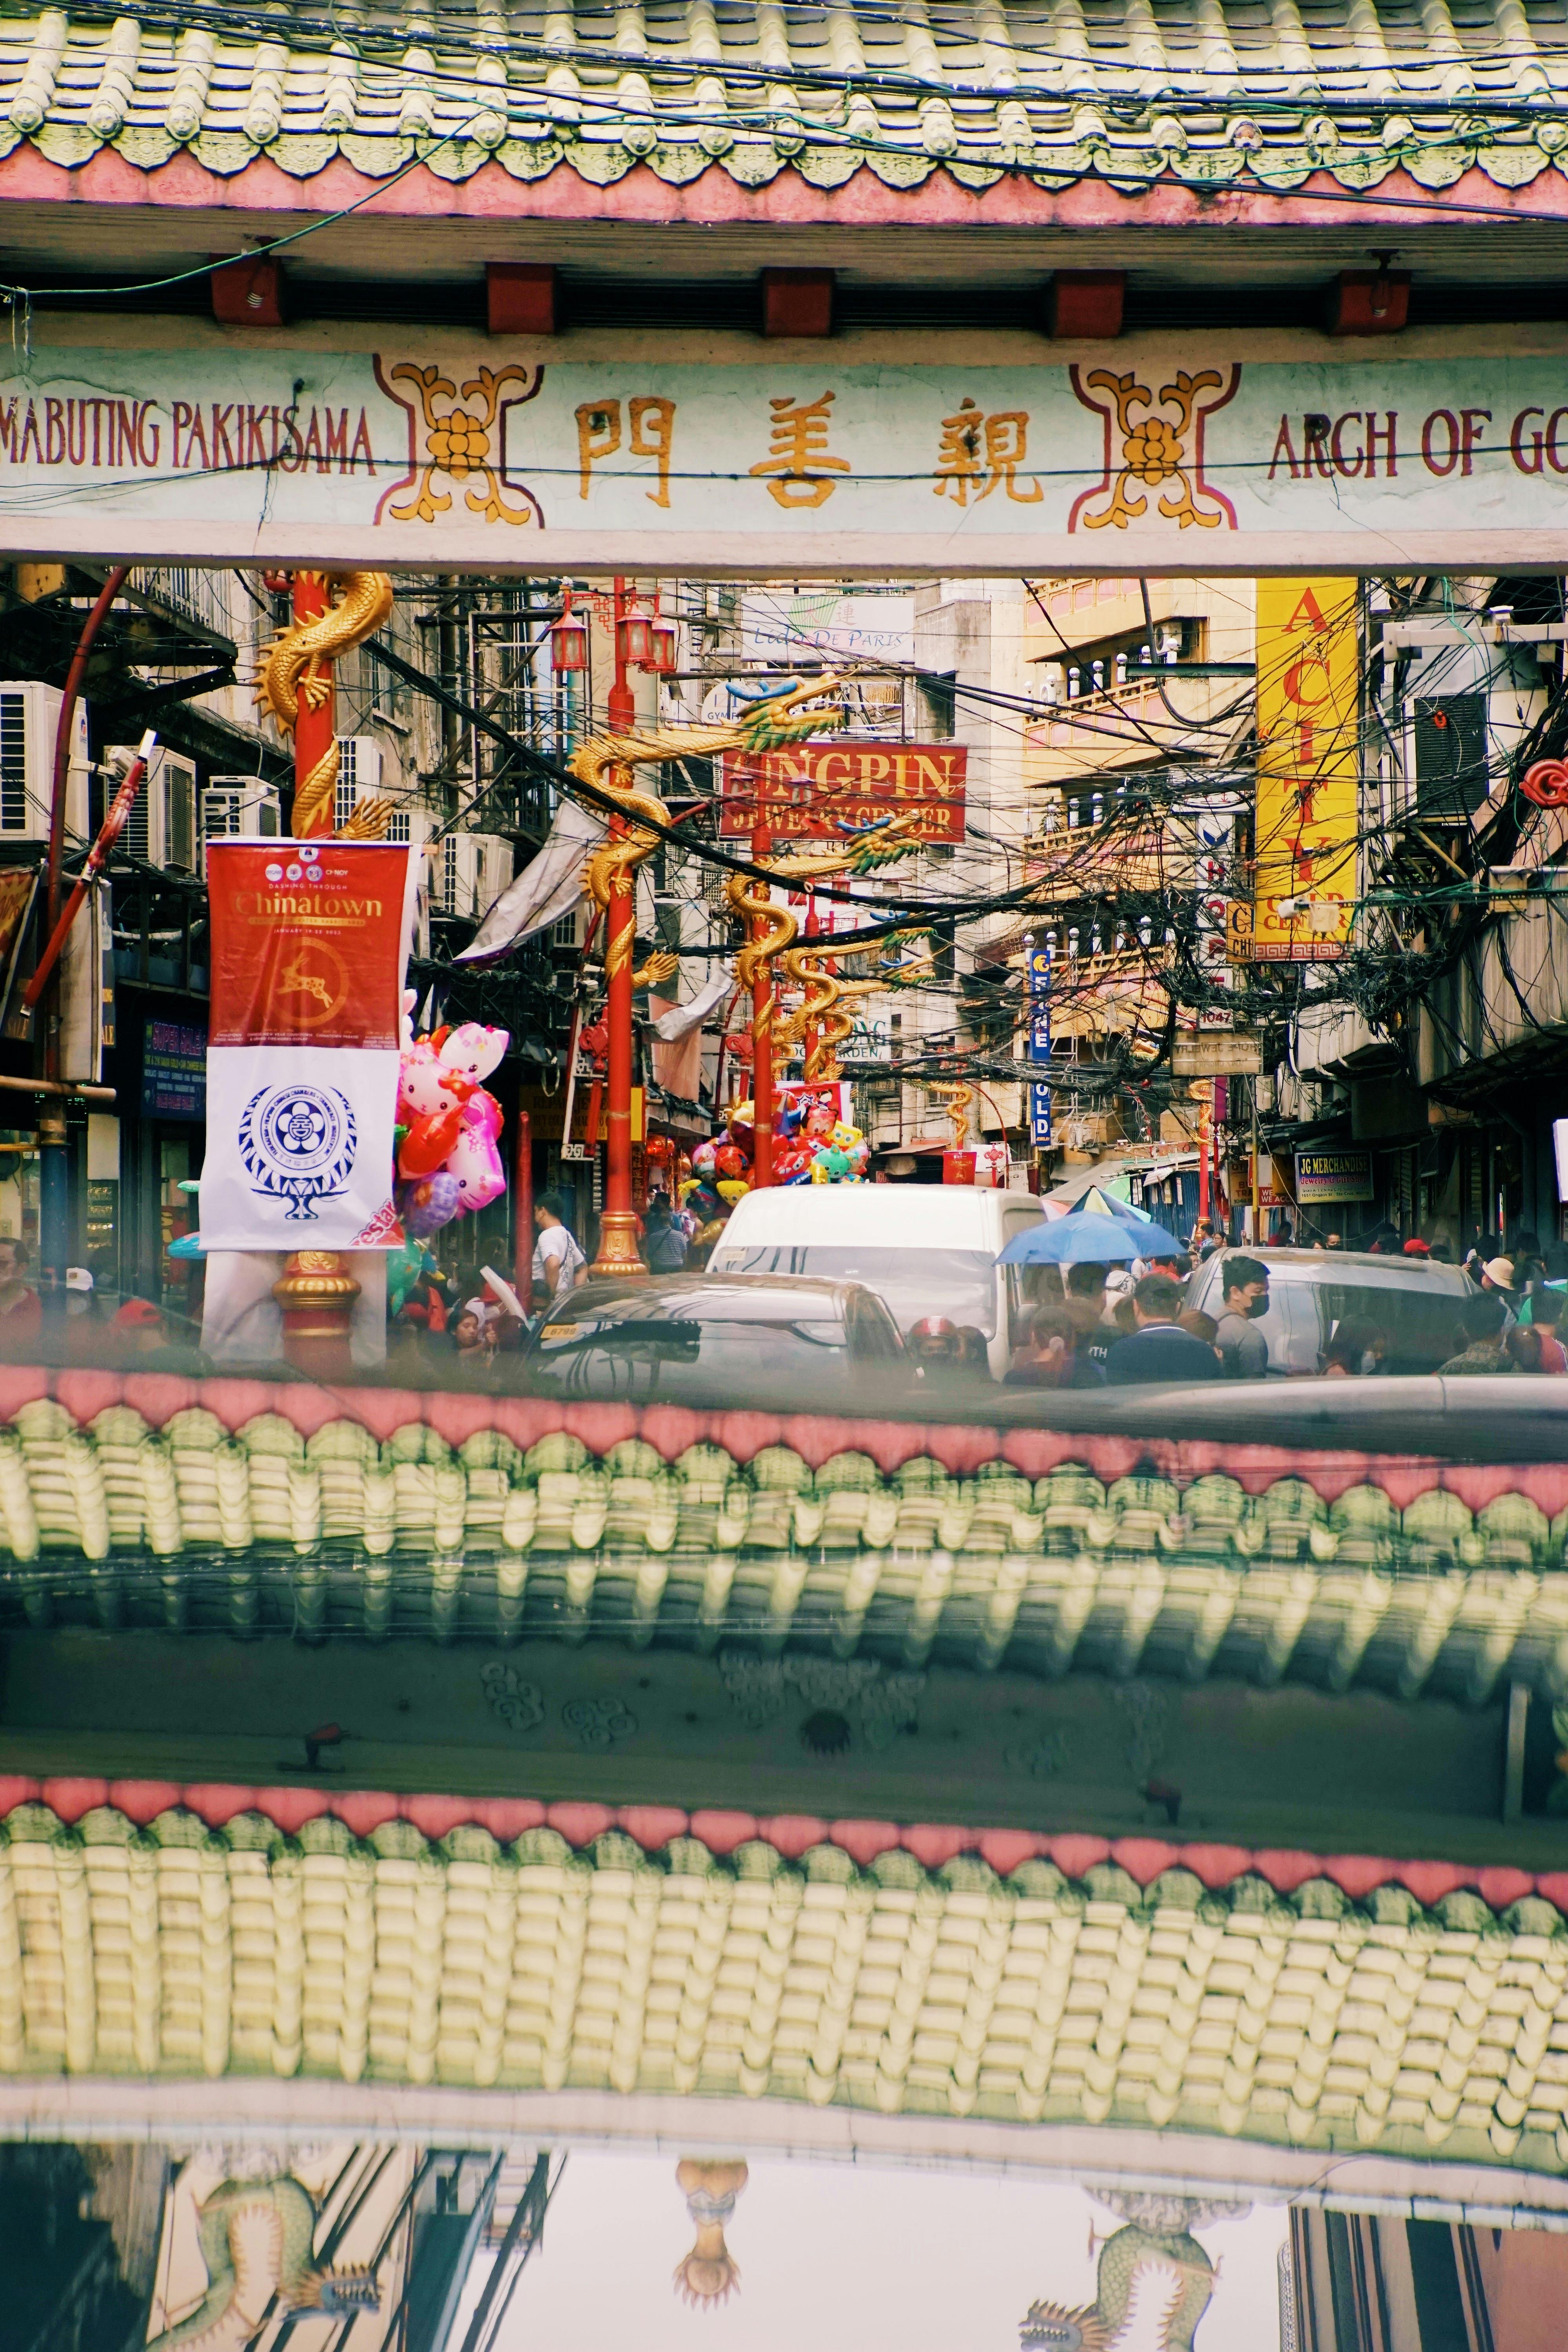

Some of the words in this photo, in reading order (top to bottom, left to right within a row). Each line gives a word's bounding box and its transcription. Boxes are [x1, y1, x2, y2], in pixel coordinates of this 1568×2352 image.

[0, 397, 160, 467] MABUTING
[172, 401, 376, 475] PAKIKISAMA
[1267, 412, 1398, 479] ARCH
[1422, 409, 1492, 476] OF
[236, 891, 382, 916] Chinatown
[1263, 914, 1347, 930] CENR
[1301, 1158, 1311, 1174] JG
[1313, 1156, 1368, 1174] MERCHANDISE
[1301, 1177, 1327, 1185] Jewelry
